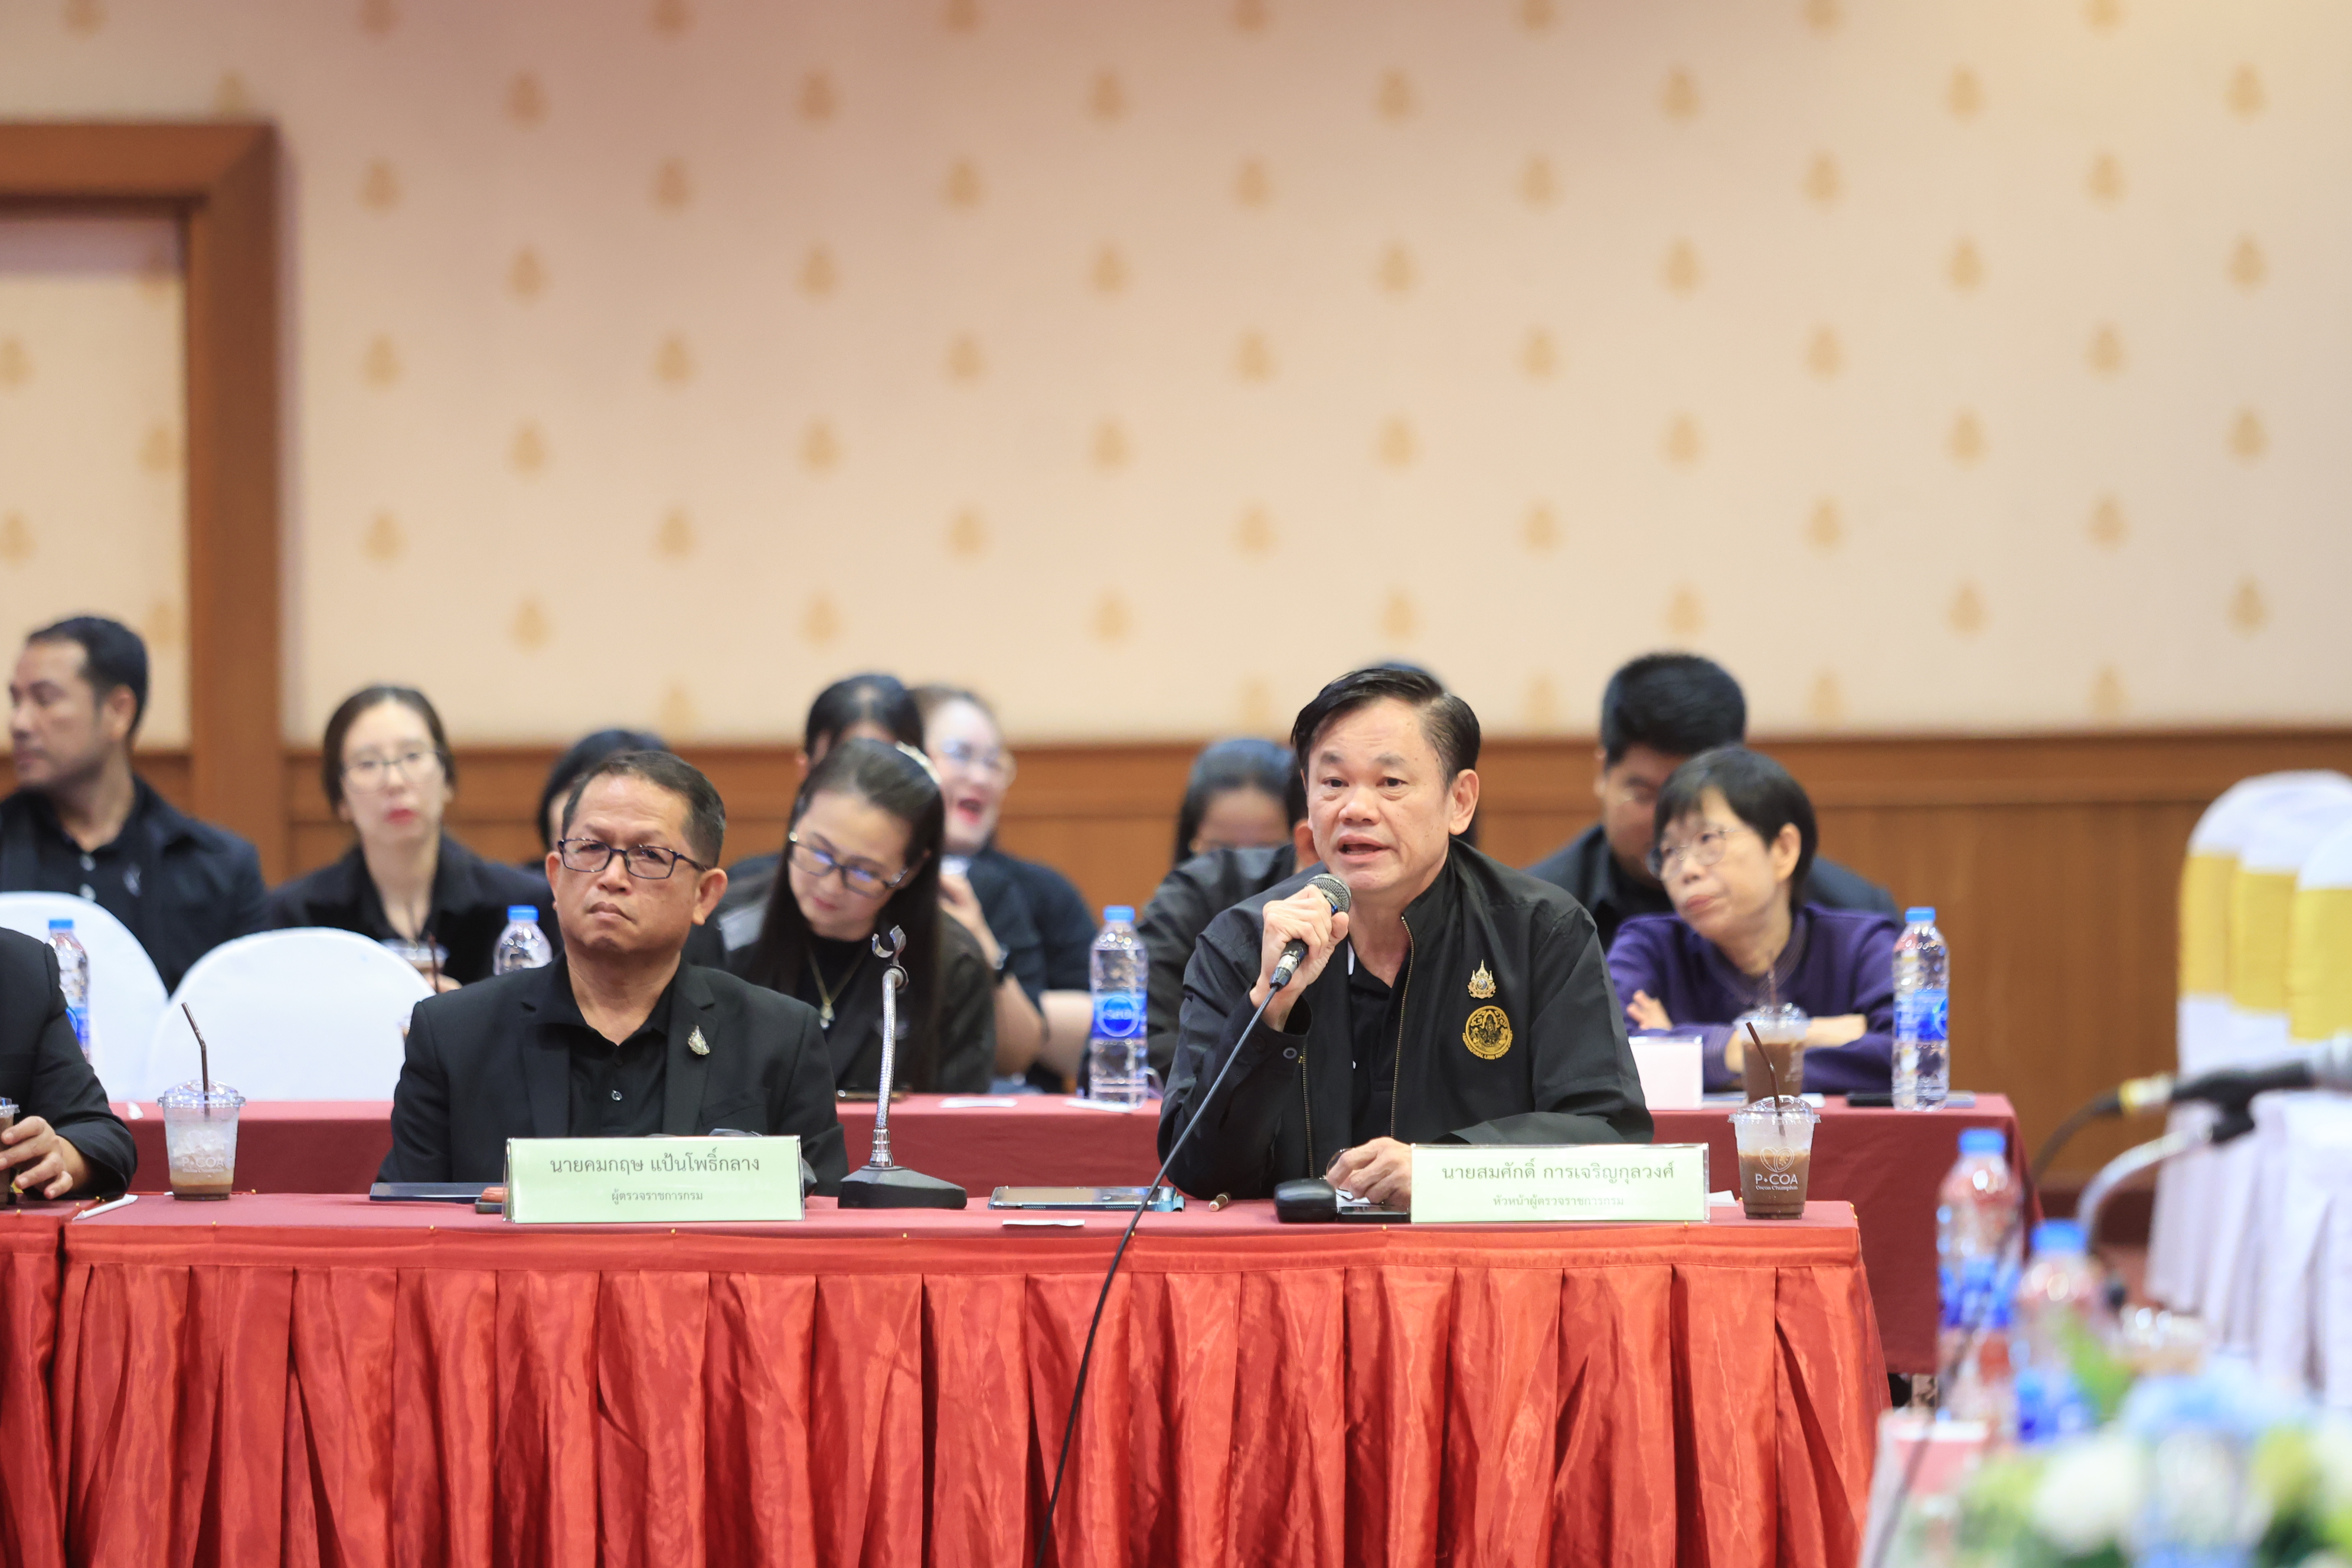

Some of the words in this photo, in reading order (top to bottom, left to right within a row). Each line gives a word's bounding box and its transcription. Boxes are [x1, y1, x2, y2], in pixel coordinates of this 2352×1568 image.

[550, 1159, 644, 1175] นายคมกฤษ
[651, 1147, 760, 1172] แป้นโพธิ์กลาง
[1442, 1157, 1536, 1180] นายสมศักดิ์
[1543, 1161, 1675, 1184] การเจริญกุลวงศ์
[612, 1189, 704, 1205] ผู้ตรวจราชการกรม
[1492, 1194, 1624, 1210] หัวหน้าผู้ตรวจราชการกรม
